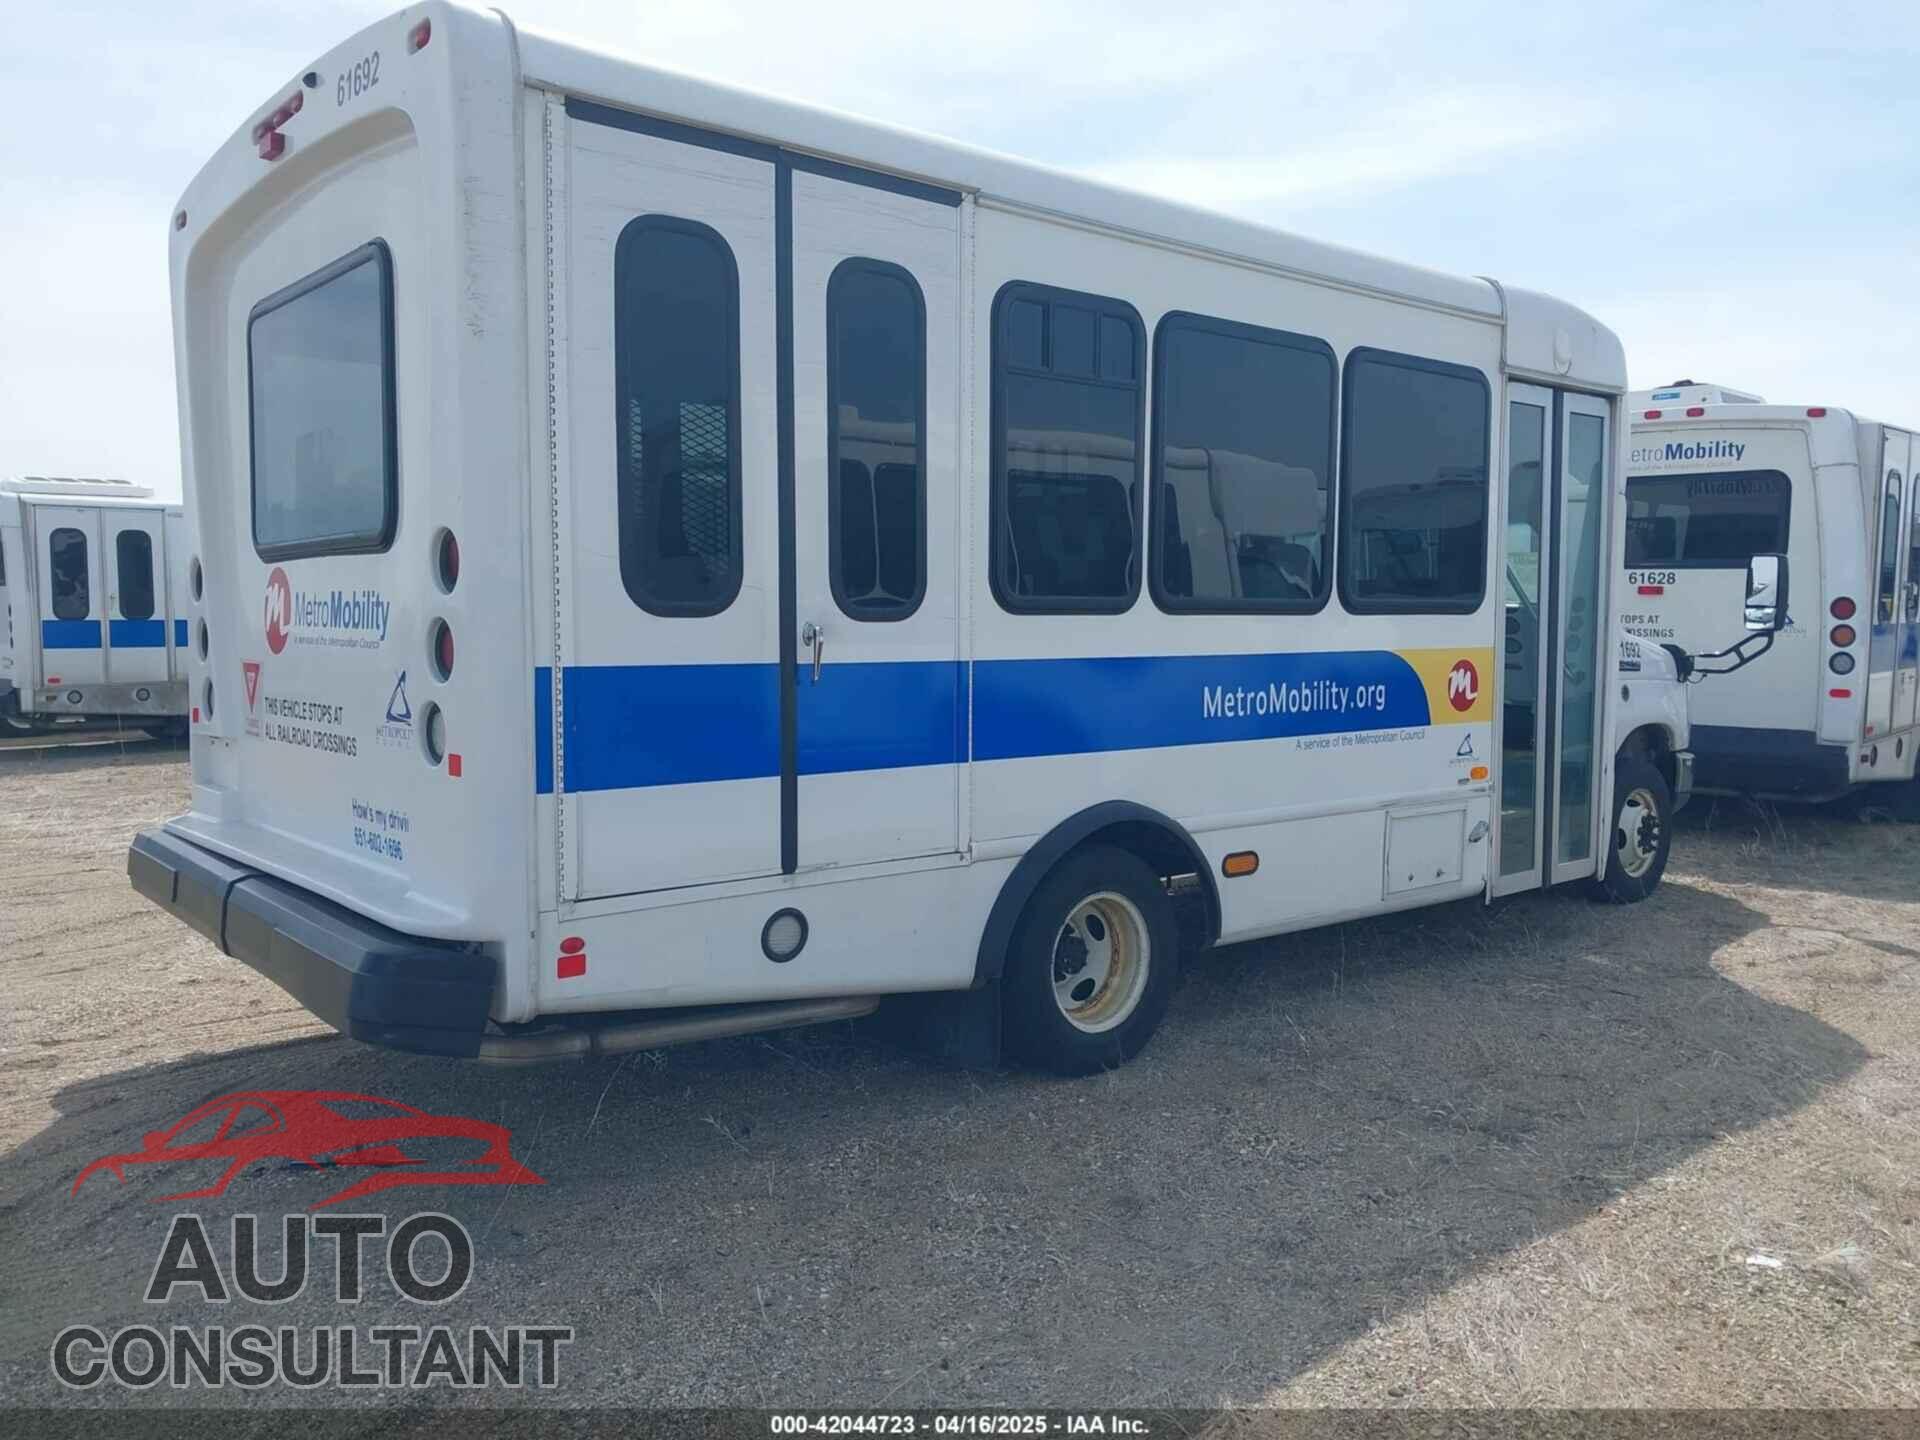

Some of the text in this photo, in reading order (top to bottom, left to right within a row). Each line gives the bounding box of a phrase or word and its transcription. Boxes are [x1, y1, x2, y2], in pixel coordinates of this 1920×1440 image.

[336, 50, 380, 107] 61692
[1630, 440, 1745, 462] etroMobility
[1628, 572, 1676, 585] 61628
[294, 590, 391, 641] MetroMobility
[1648, 615, 1659, 624] AT
[1620, 641, 1641, 658] 1692
[264, 696, 343, 725] THIS VEHICLE STOPS AT
[1203, 680, 1386, 718] MetroMobility.org
[265, 722, 277, 741] ALL
[278, 725, 311, 748] RAILROAD
[313, 731, 357, 757] CROSSINGS
